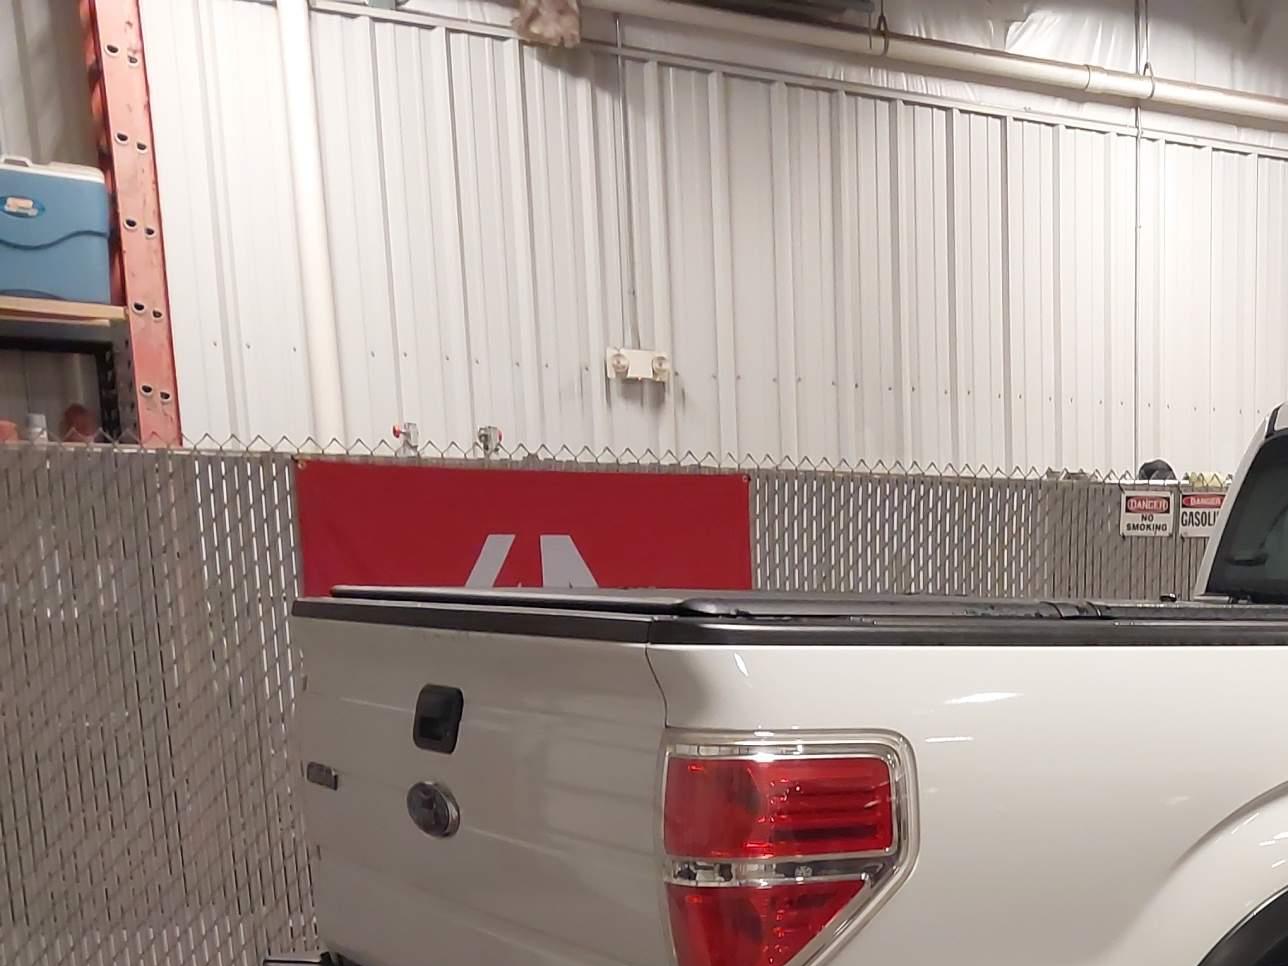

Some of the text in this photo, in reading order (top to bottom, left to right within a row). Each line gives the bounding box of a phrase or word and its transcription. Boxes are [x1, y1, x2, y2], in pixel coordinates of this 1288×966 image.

[1141, 514, 1154, 522] NO
[1181, 511, 1219, 527] GASOLI
[1126, 523, 1168, 532] SMOKING
